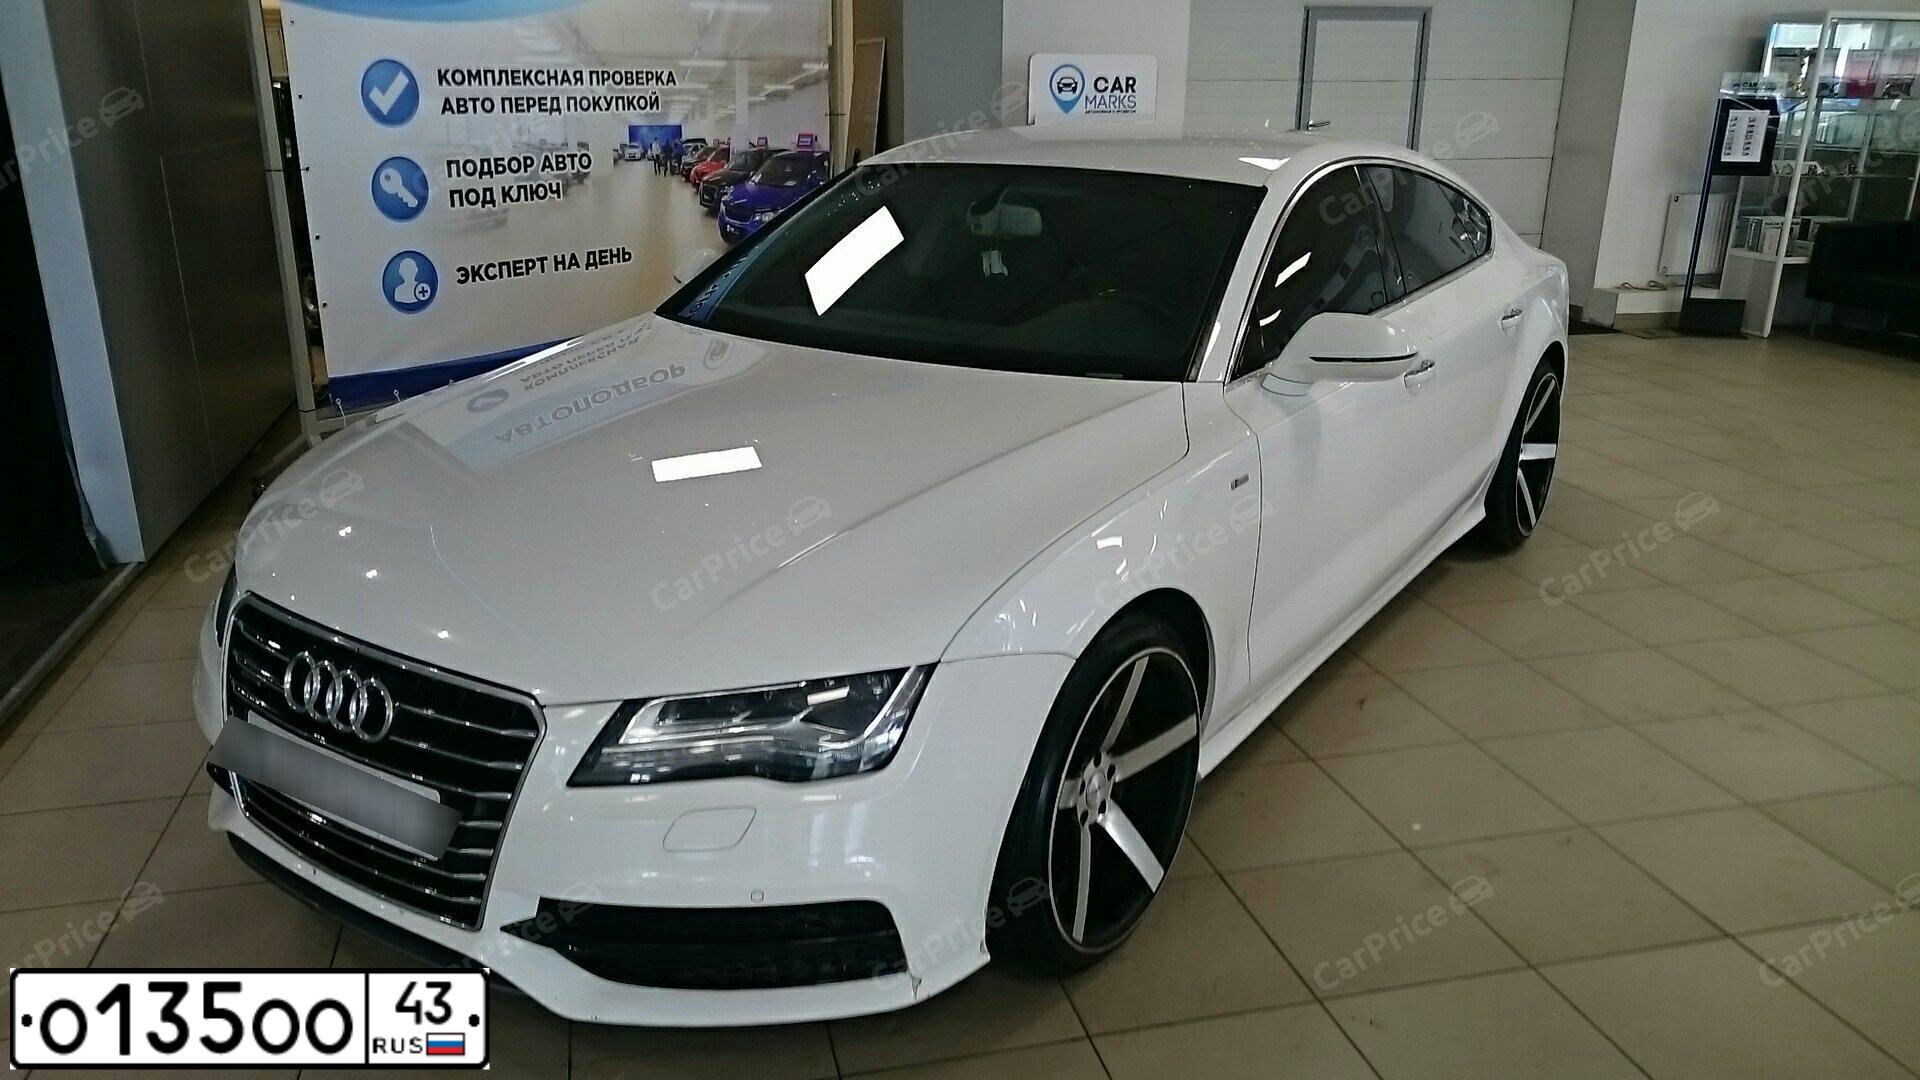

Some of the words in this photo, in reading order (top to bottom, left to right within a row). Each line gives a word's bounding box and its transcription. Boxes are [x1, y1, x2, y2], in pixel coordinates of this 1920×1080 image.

[437, 68, 584, 87] КОМПЛЕКСНАЯ
[588, 69, 677, 87] ПРОВЕРКА
[1093, 76, 1137, 94] CAR
[440, 96, 496, 116] АВТО
[500, 95, 562, 116] ПЕРЕД
[566, 91, 661, 113] ПОКУПКОЙ
[1084, 94, 1137, 110] MARKS
[446, 154, 536, 179] ПОДБОР
[540, 151, 593, 173] АВТО
[449, 186, 496, 209] ПОД
[501, 181, 562, 204] КЛЮЧ
[456, 255, 549, 285] ЭКСПЕРТ
[553, 252, 581, 272] НА
[585, 246, 632, 271] ДЕНЬ
